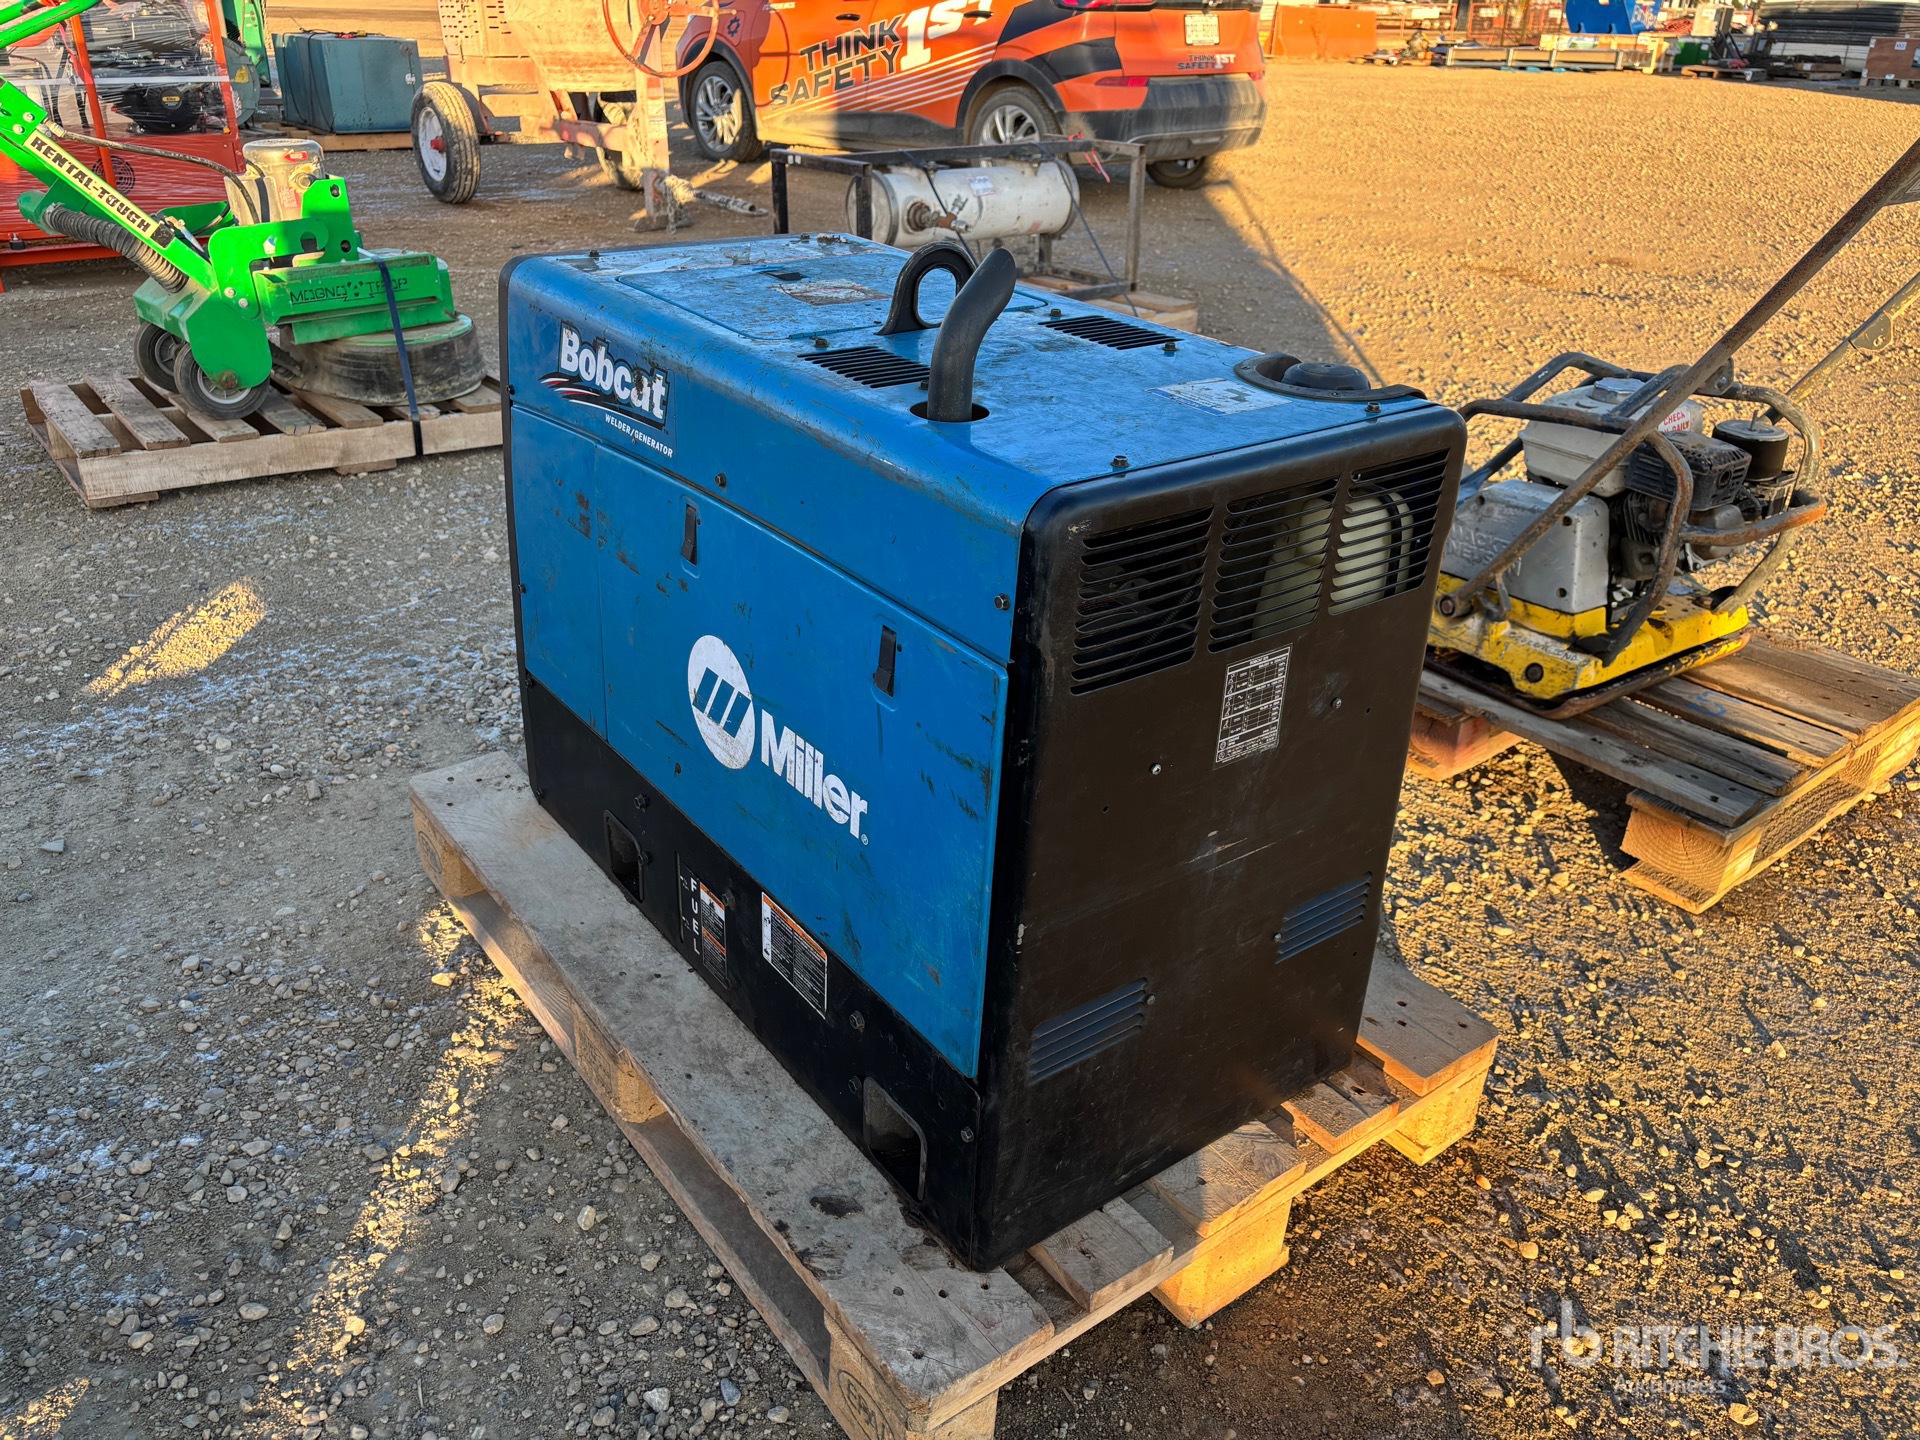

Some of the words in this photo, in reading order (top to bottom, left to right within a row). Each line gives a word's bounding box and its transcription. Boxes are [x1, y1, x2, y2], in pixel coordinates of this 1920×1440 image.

[770, 44, 902, 109] SAFETY
[800, 14, 904, 72] THINK
[30, 136, 151, 233] RENTAL-TOUGH
[560, 327, 666, 420] Bobcat
[605, 412, 674, 458] WELDER/GENERATOR
[1663, 411, 1686, 426] CHECK
[760, 708, 868, 839] Miller
[689, 877, 701, 955] FUEL
